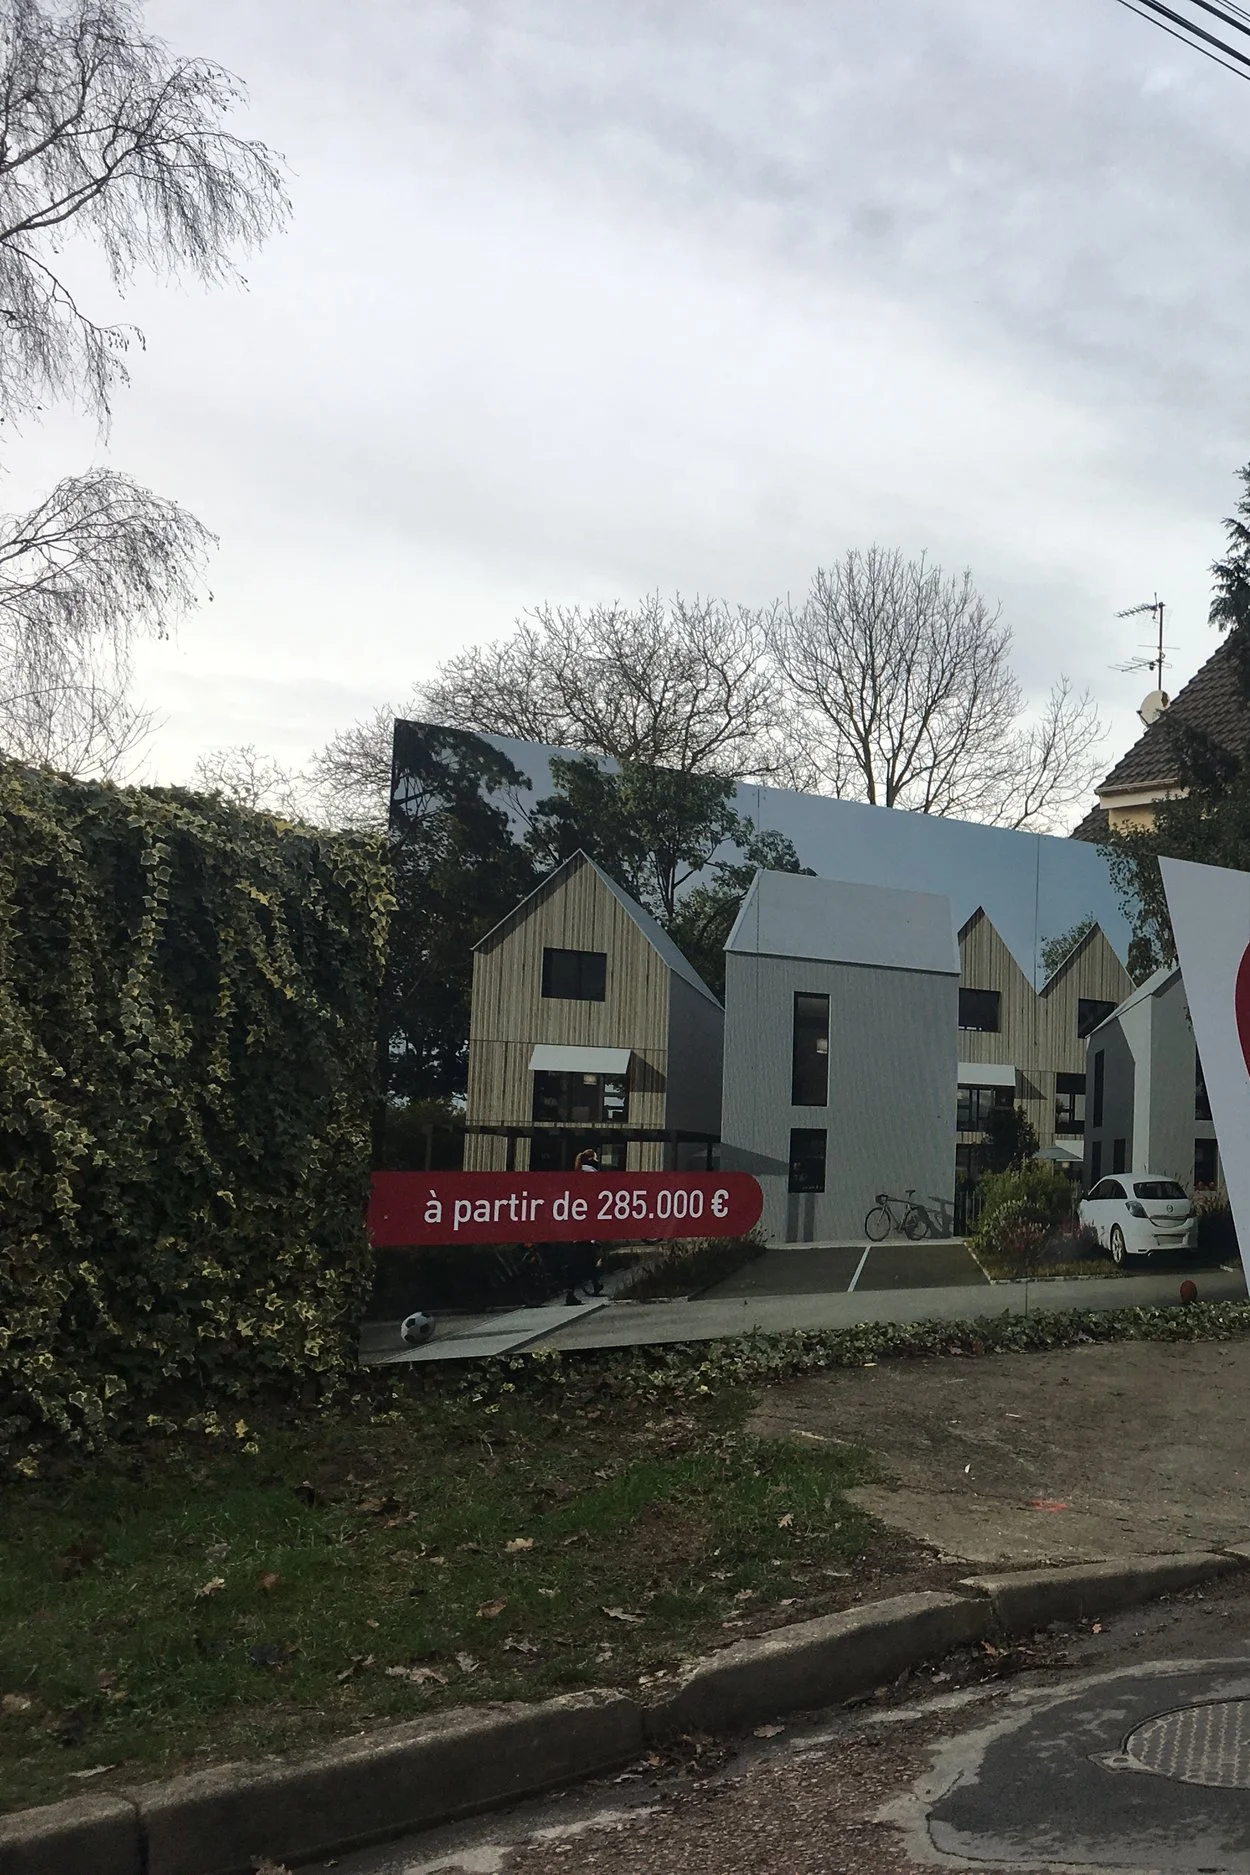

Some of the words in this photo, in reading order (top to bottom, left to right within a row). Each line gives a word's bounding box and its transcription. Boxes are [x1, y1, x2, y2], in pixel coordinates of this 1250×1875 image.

[424, 1190, 442, 1224] à
[453, 1191, 545, 1231] partir
[552, 1190, 588, 1222] de
[597, 1189, 704, 1221] 285.000
[711, 1188, 730, 1219] €
